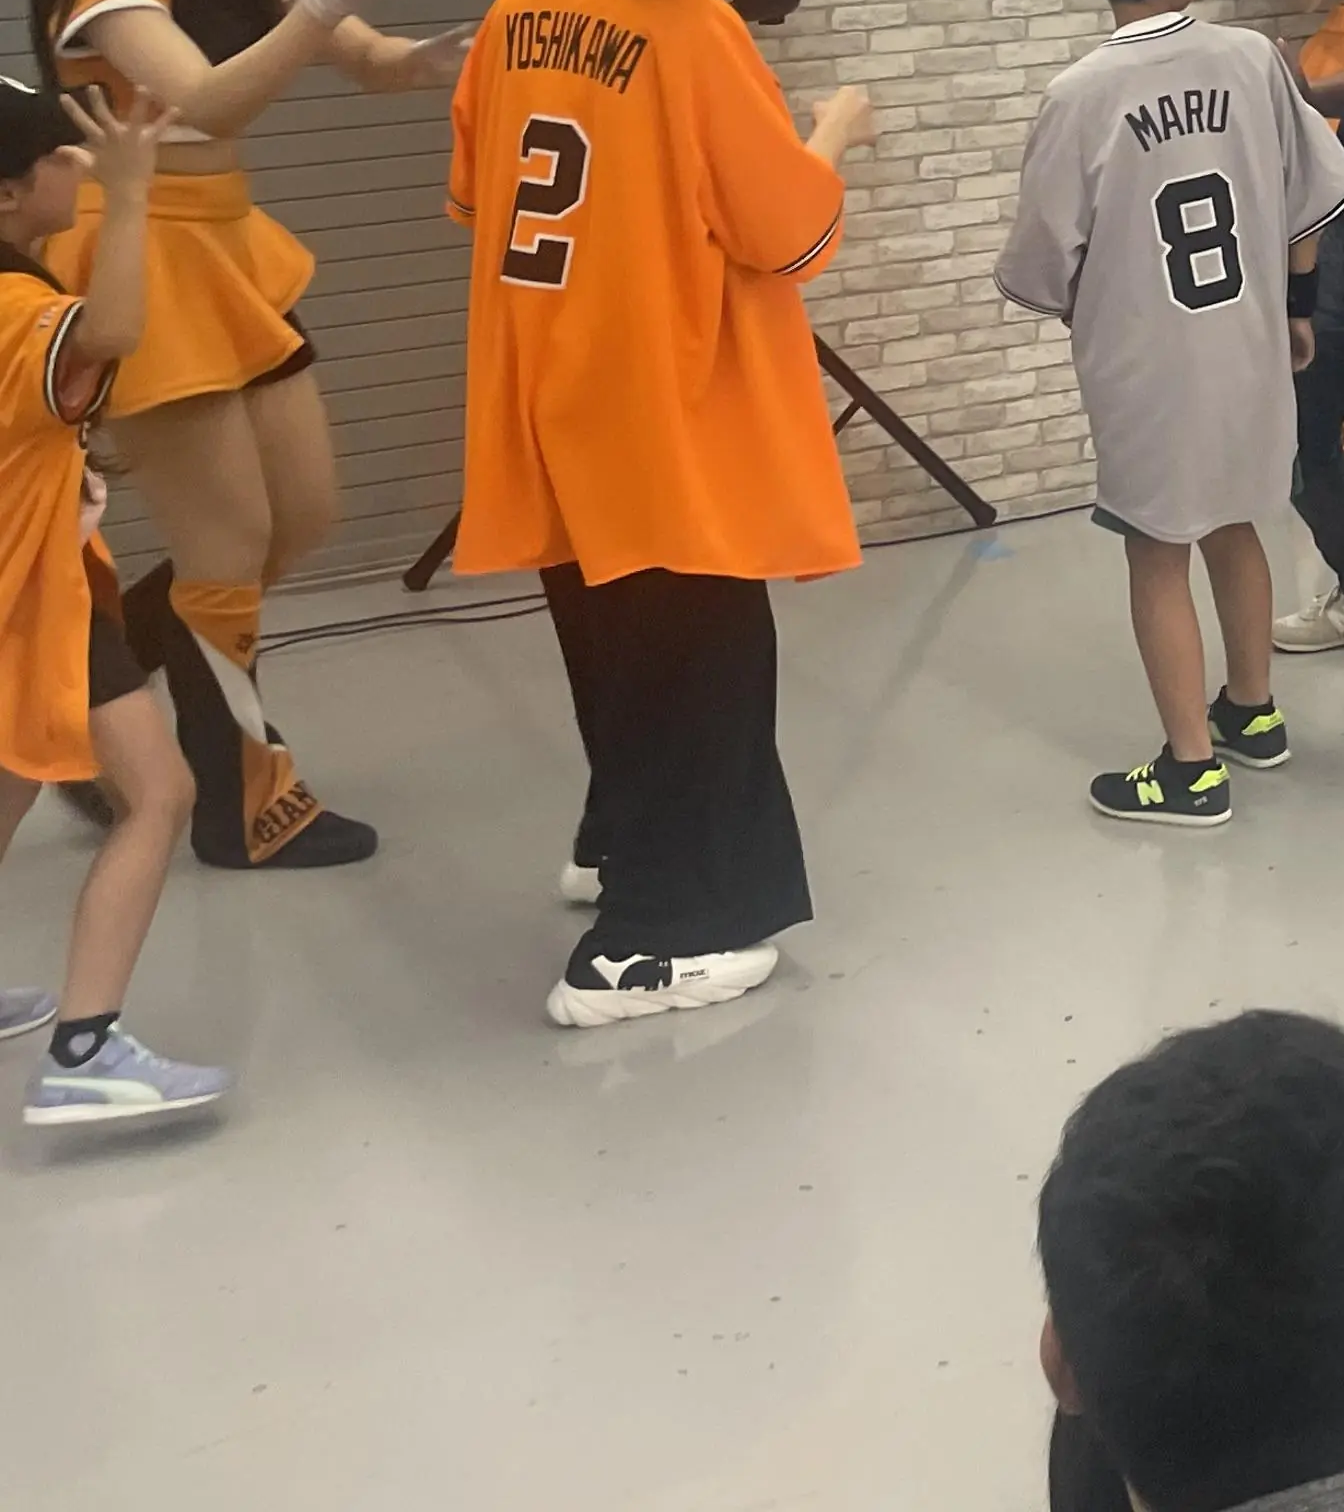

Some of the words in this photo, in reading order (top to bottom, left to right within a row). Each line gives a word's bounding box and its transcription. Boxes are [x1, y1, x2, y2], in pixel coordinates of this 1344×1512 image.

[505, 10, 648, 95] YOSHIKAWA
[1124, 88, 1231, 153] MARU
[500, 112, 593, 290] 2
[1150, 169, 1246, 314] 8
